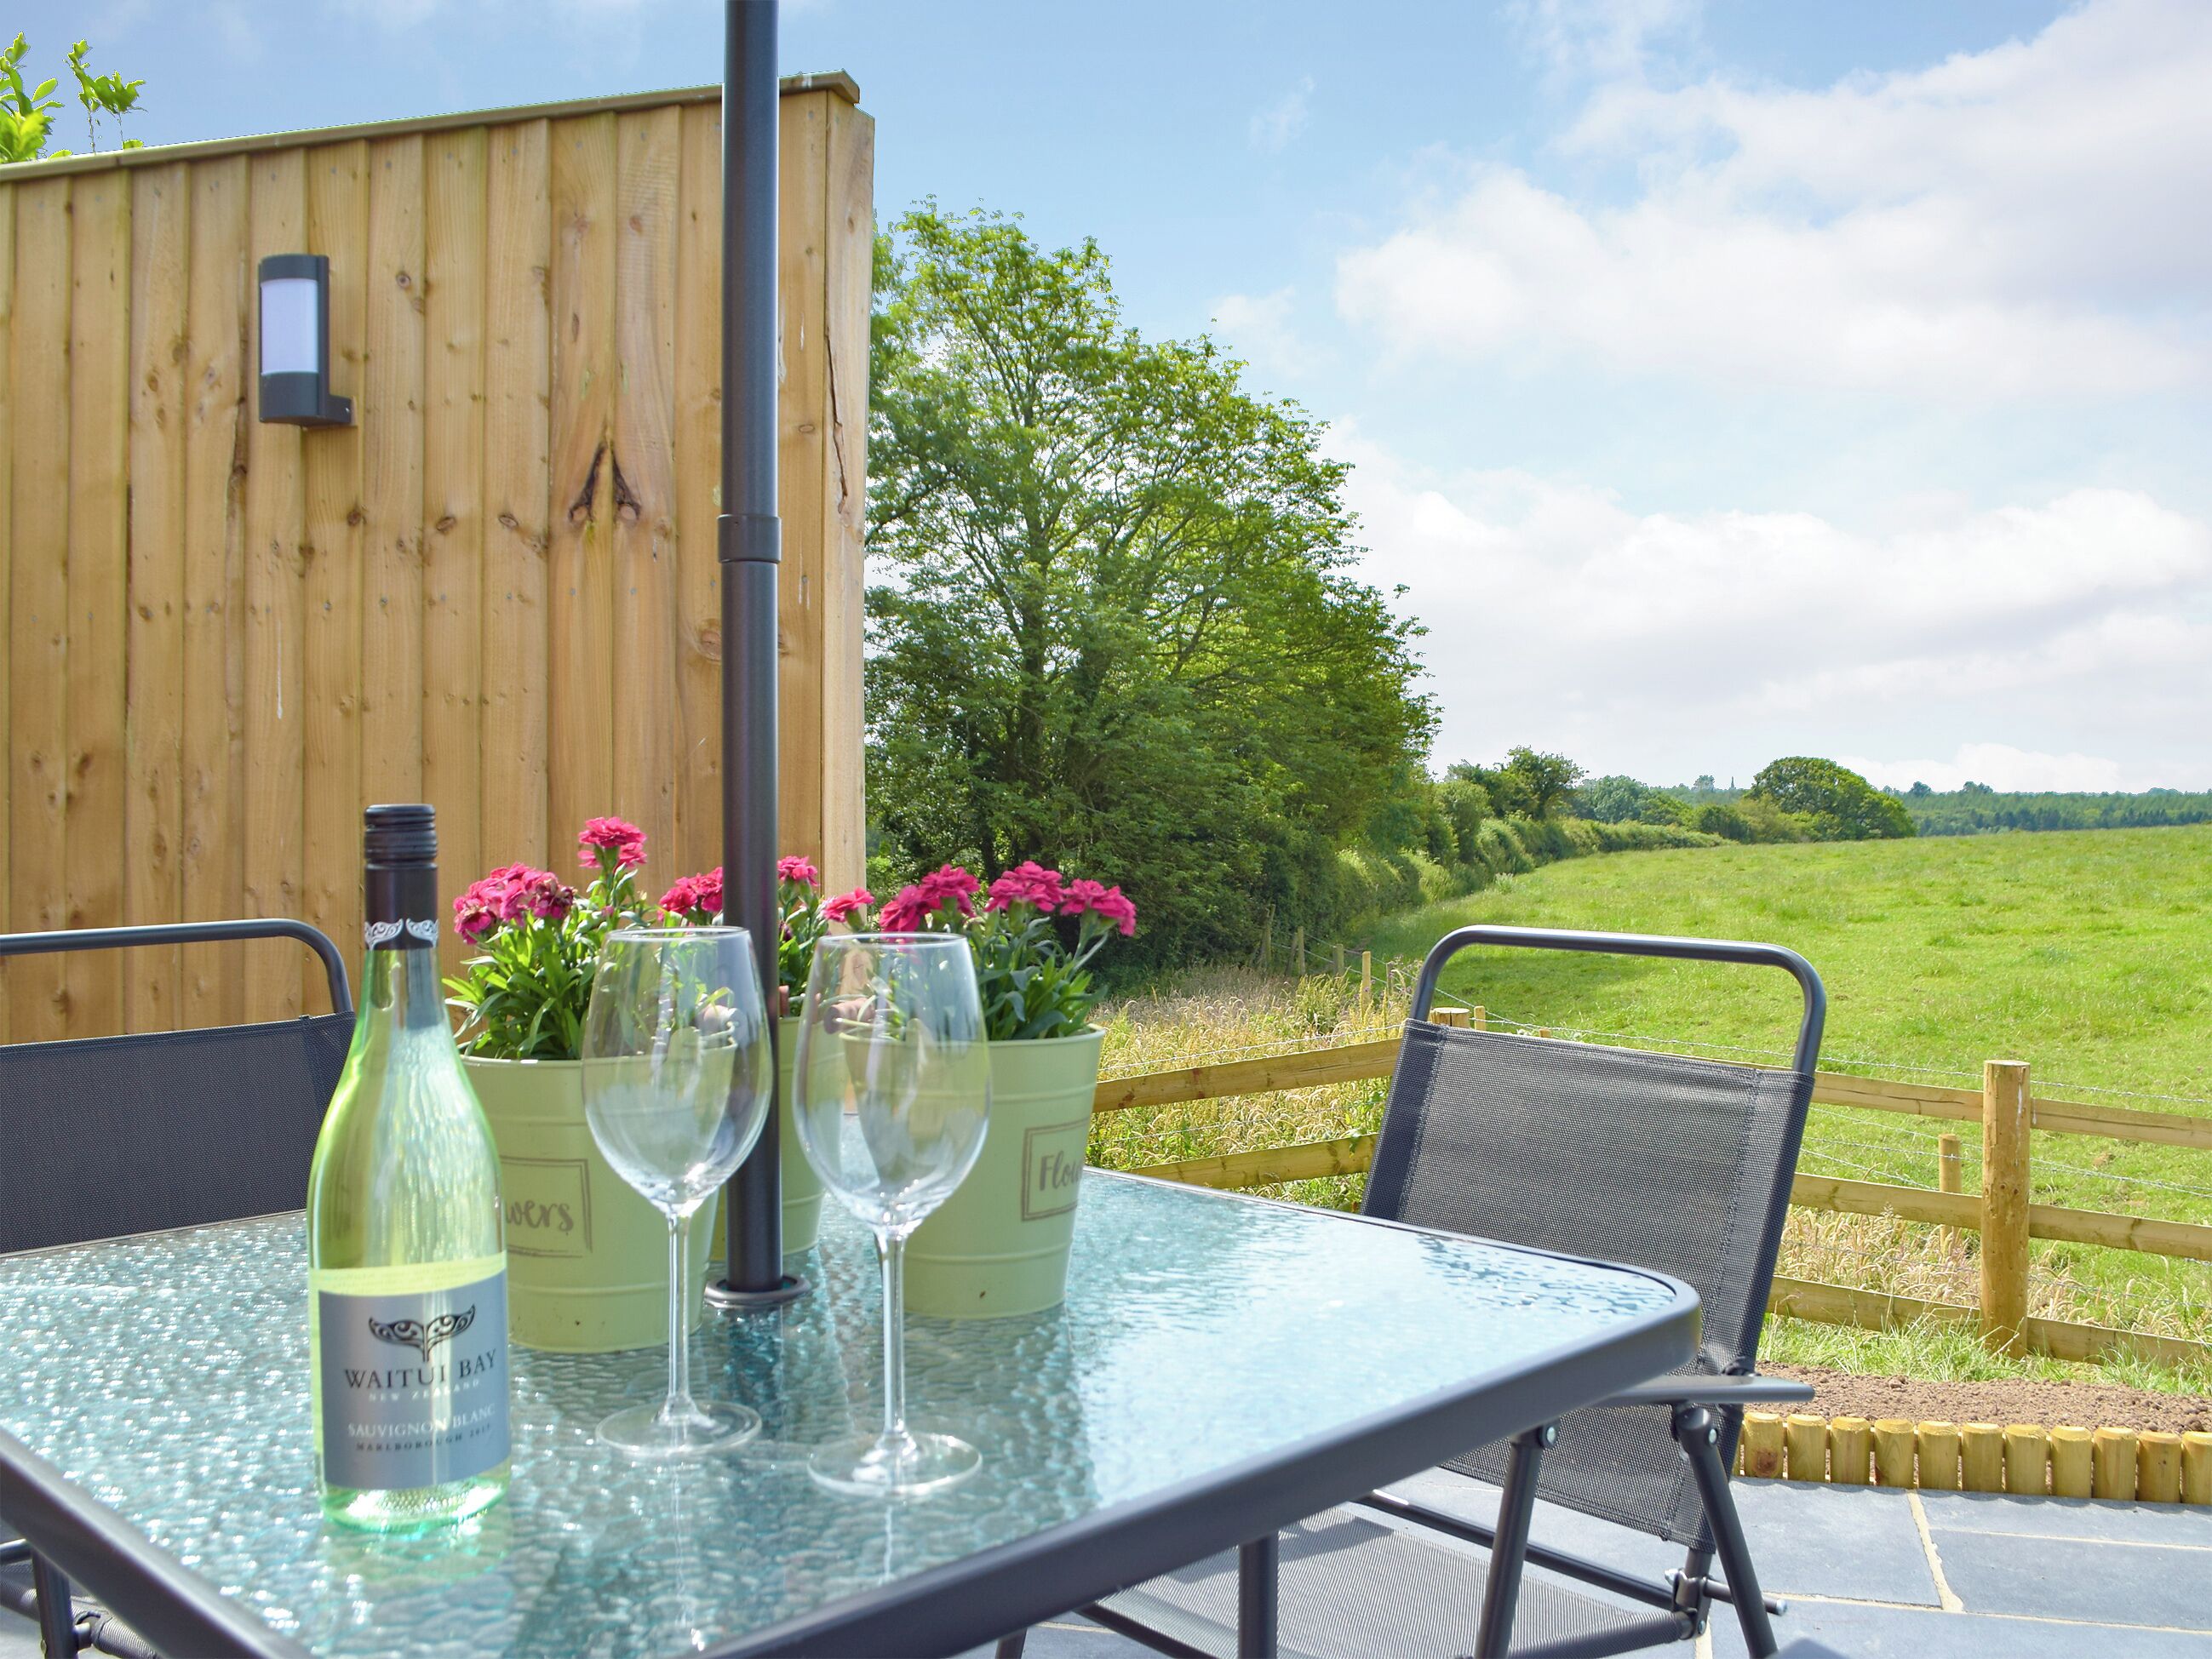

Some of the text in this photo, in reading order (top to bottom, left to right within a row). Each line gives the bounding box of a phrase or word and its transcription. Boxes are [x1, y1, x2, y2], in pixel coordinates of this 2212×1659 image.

[506, 1199, 574, 1232] wers
[345, 1348, 496, 1389] WAITUI BAY
[369, 1393, 399, 1402] NEW
[347, 1404, 496, 1438] SAUVIGNON BLANC
[356, 1434, 462, 1451] MARLBOROUGH
